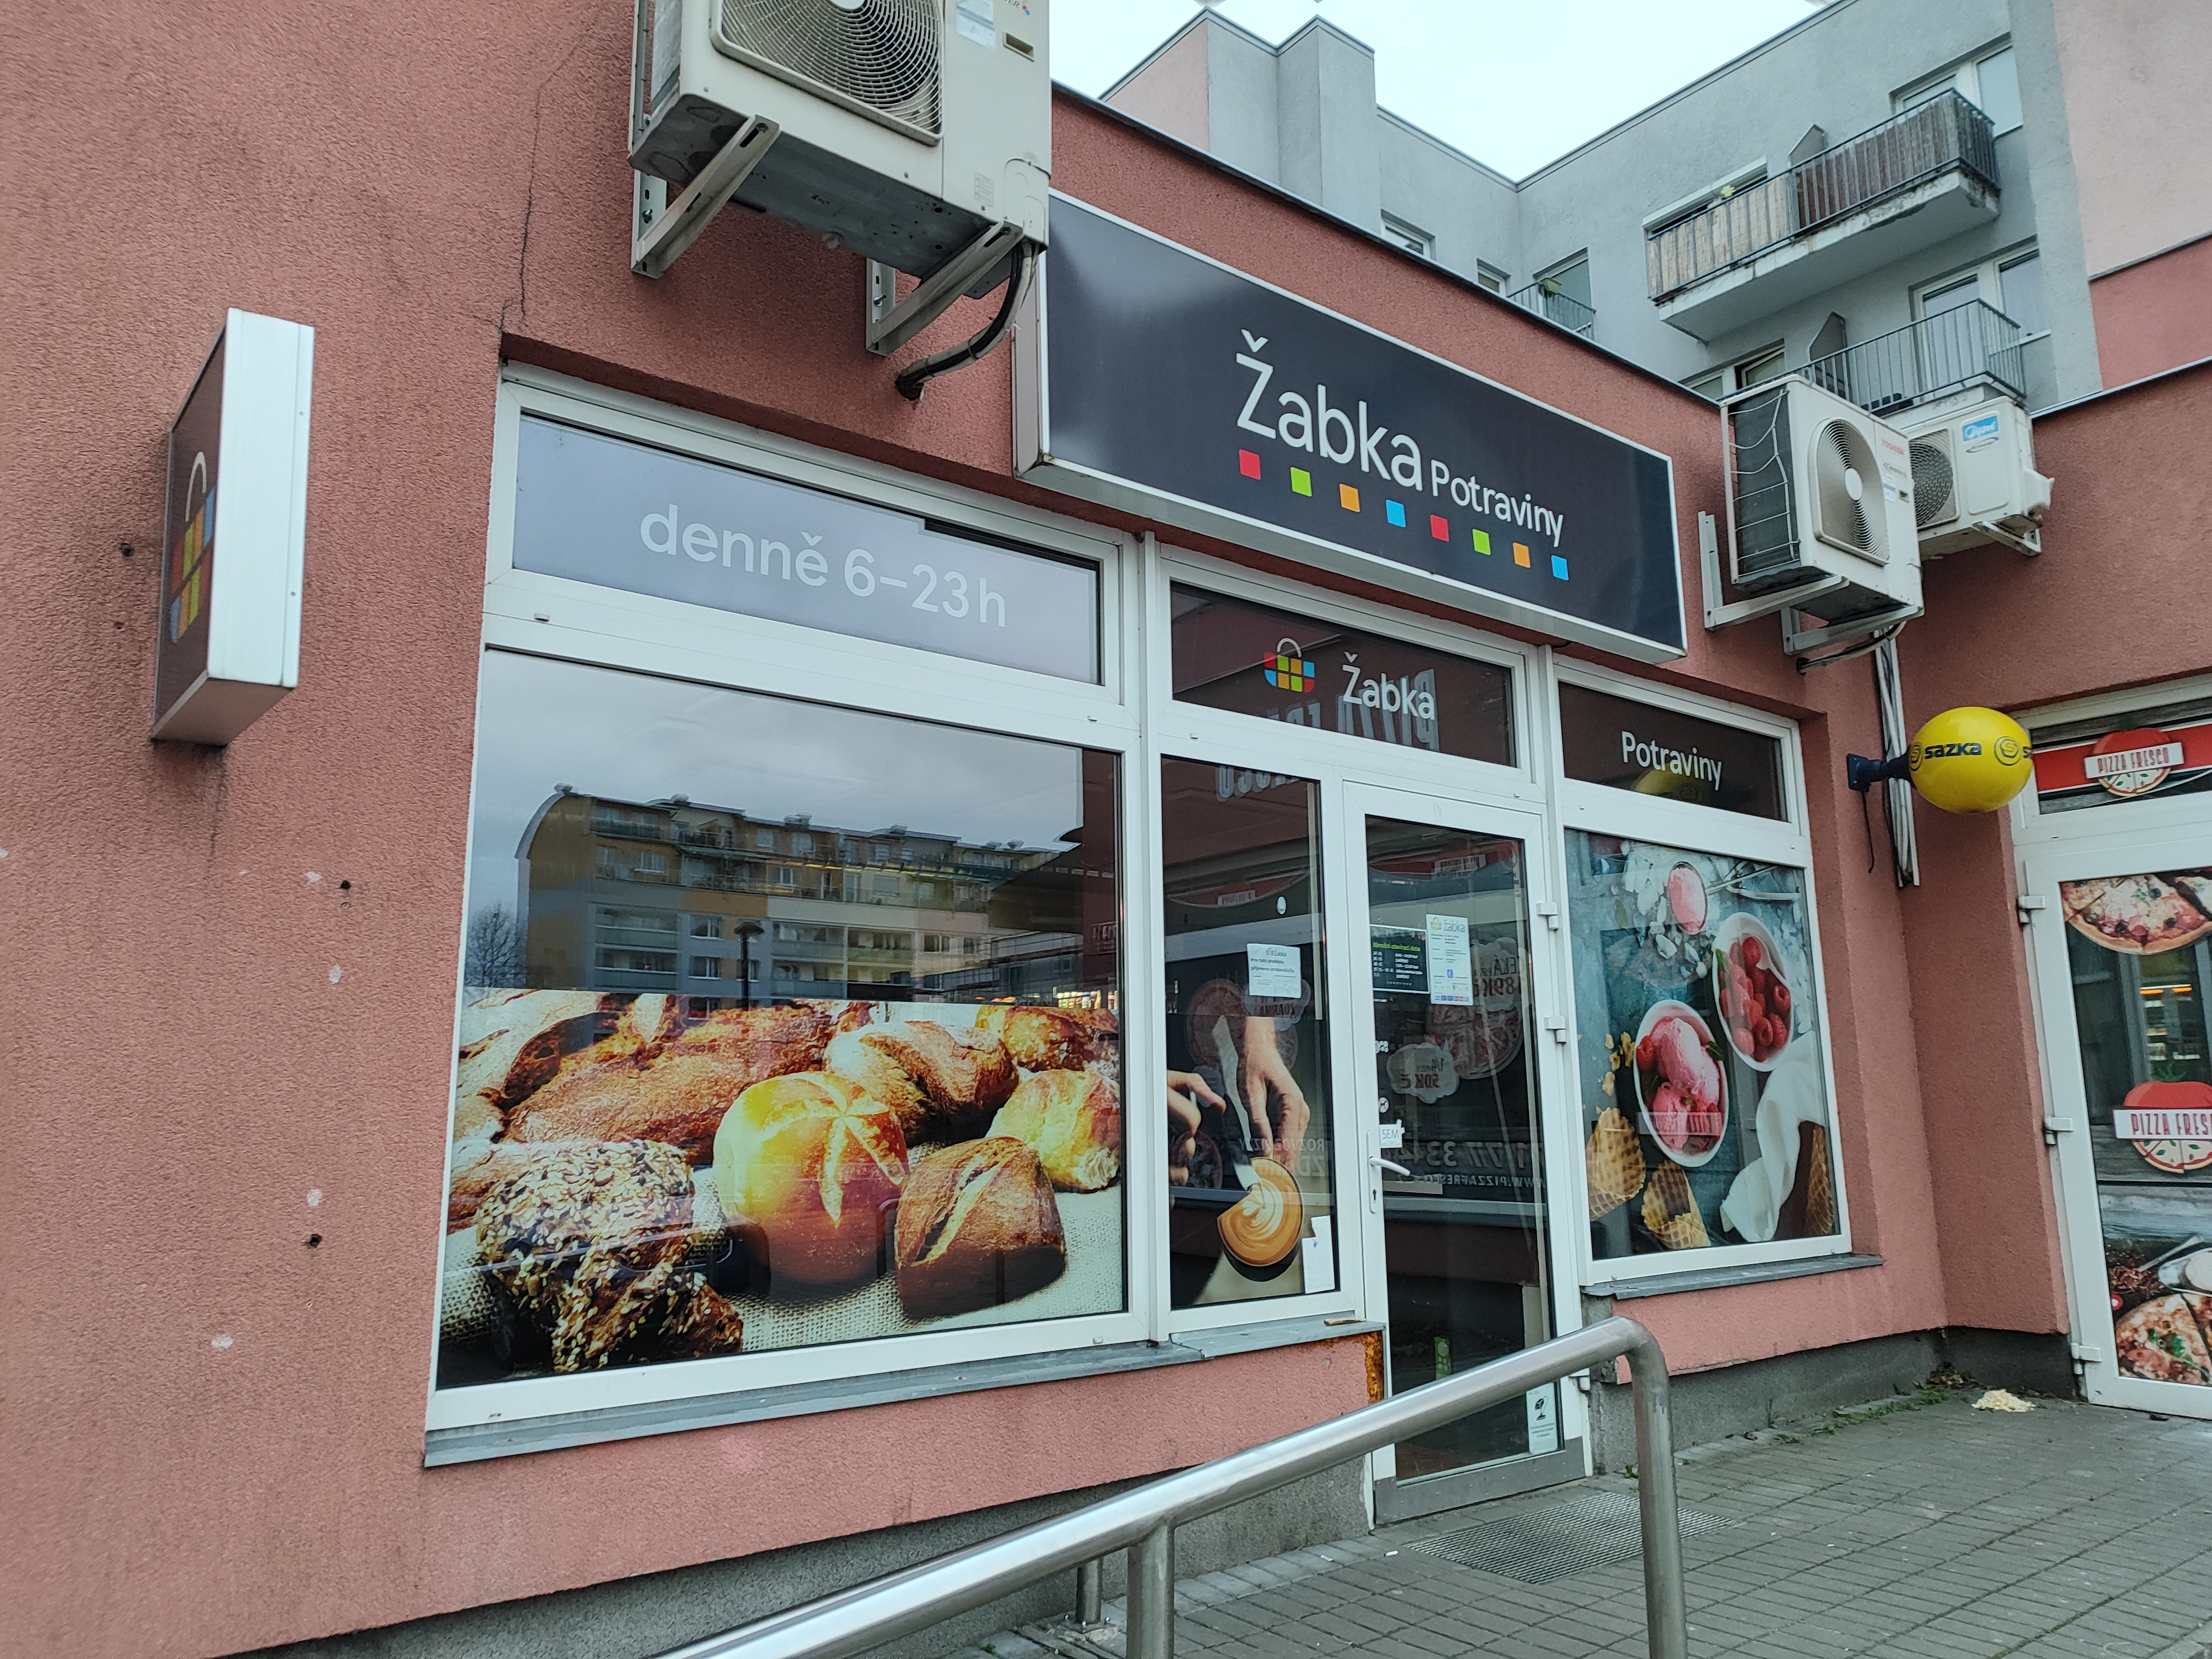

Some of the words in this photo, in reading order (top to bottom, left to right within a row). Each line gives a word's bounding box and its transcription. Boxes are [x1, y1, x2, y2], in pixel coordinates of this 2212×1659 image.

[1235, 328, 1423, 491] Žabka
[1431, 459, 1564, 547] Potraviny
[640, 503, 829, 587] denně
[1342, 651, 1436, 721] Žabka
[1620, 730, 1722, 791] Potraviny
[2131, 1113, 2171, 1135] PIZZA
[2175, 1113, 2212, 1135] FRES
